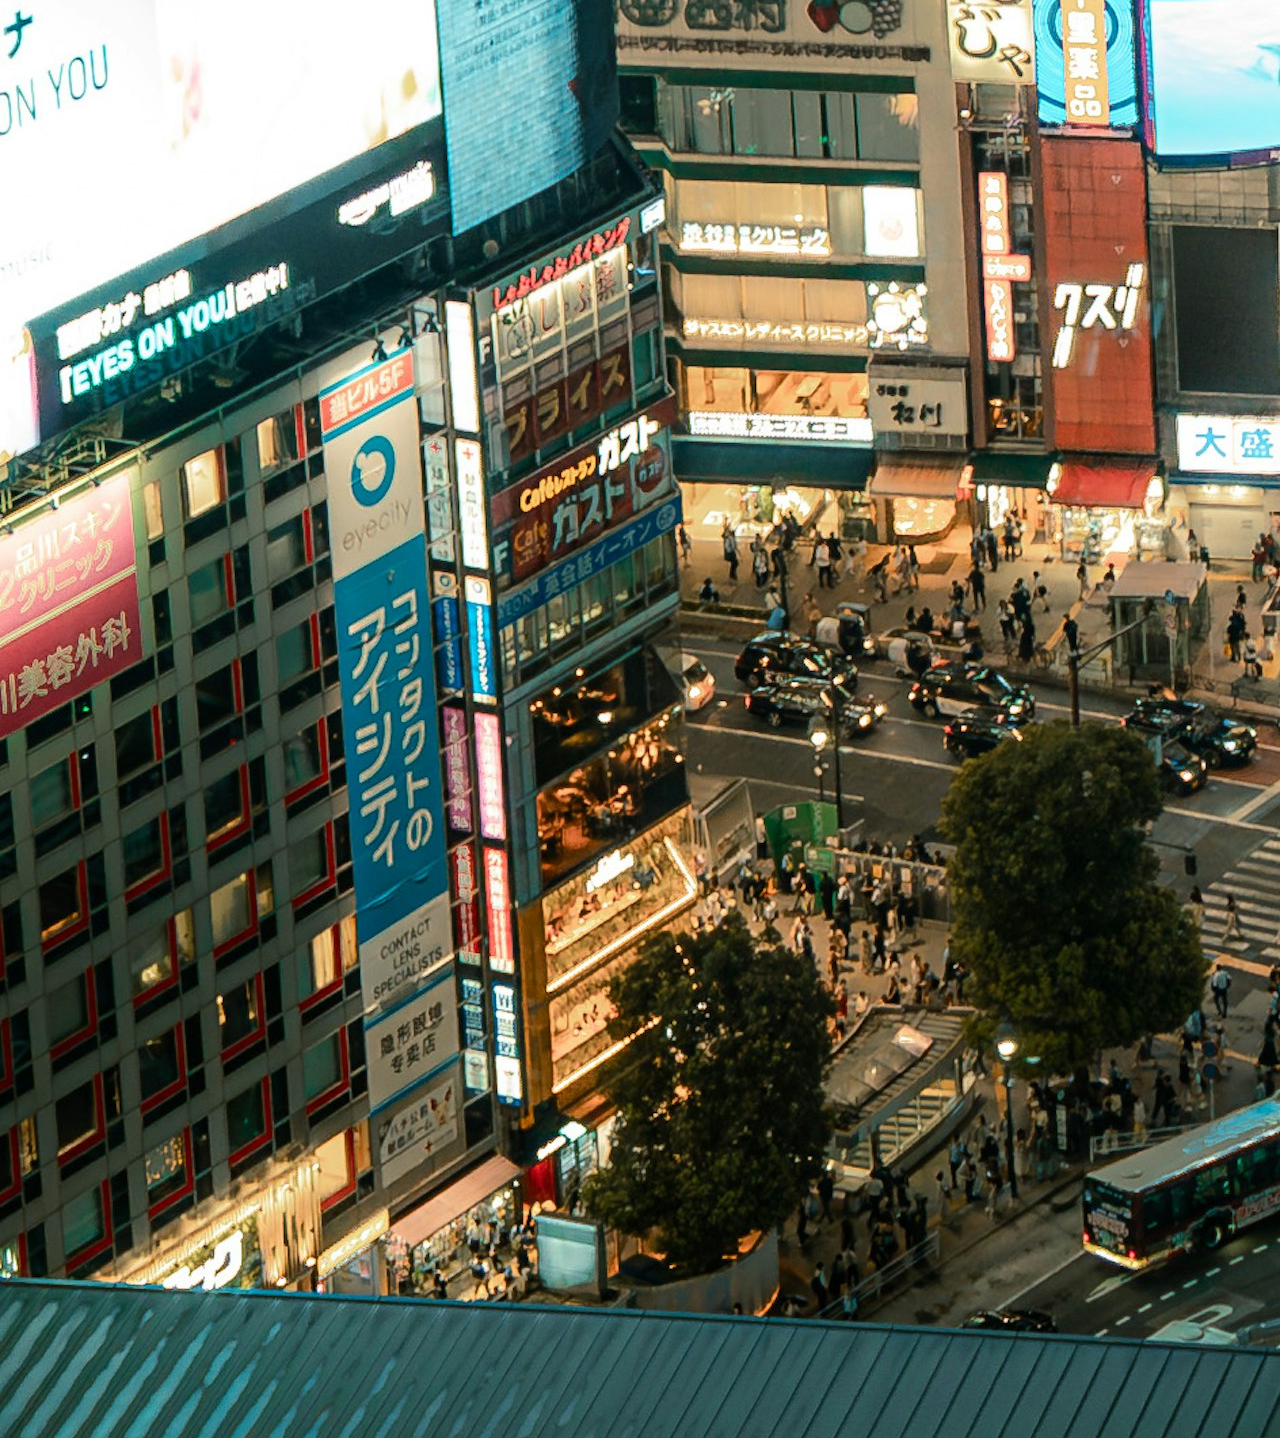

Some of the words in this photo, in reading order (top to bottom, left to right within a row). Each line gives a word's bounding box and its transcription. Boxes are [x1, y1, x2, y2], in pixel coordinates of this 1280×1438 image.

[47, 43, 109, 110] YOU
[138, 318, 177, 359] ON
[598, 415, 661, 477] ガスト
[14, 500, 123, 581] 品川スキン
[341, 494, 413, 554] eyecity
[552, 475, 626, 552] ガスト
[17, 538, 114, 615] クリニック
[543, 520, 652, 601] 英会話イーオン
[346, 606, 396, 868] アイシティ
[392, 588, 434, 851] コンタクトの
[379, 918, 432, 960] CONTACT
[391, 941, 422, 971] LENS
[372, 946, 444, 1001] SPECIALISTS
